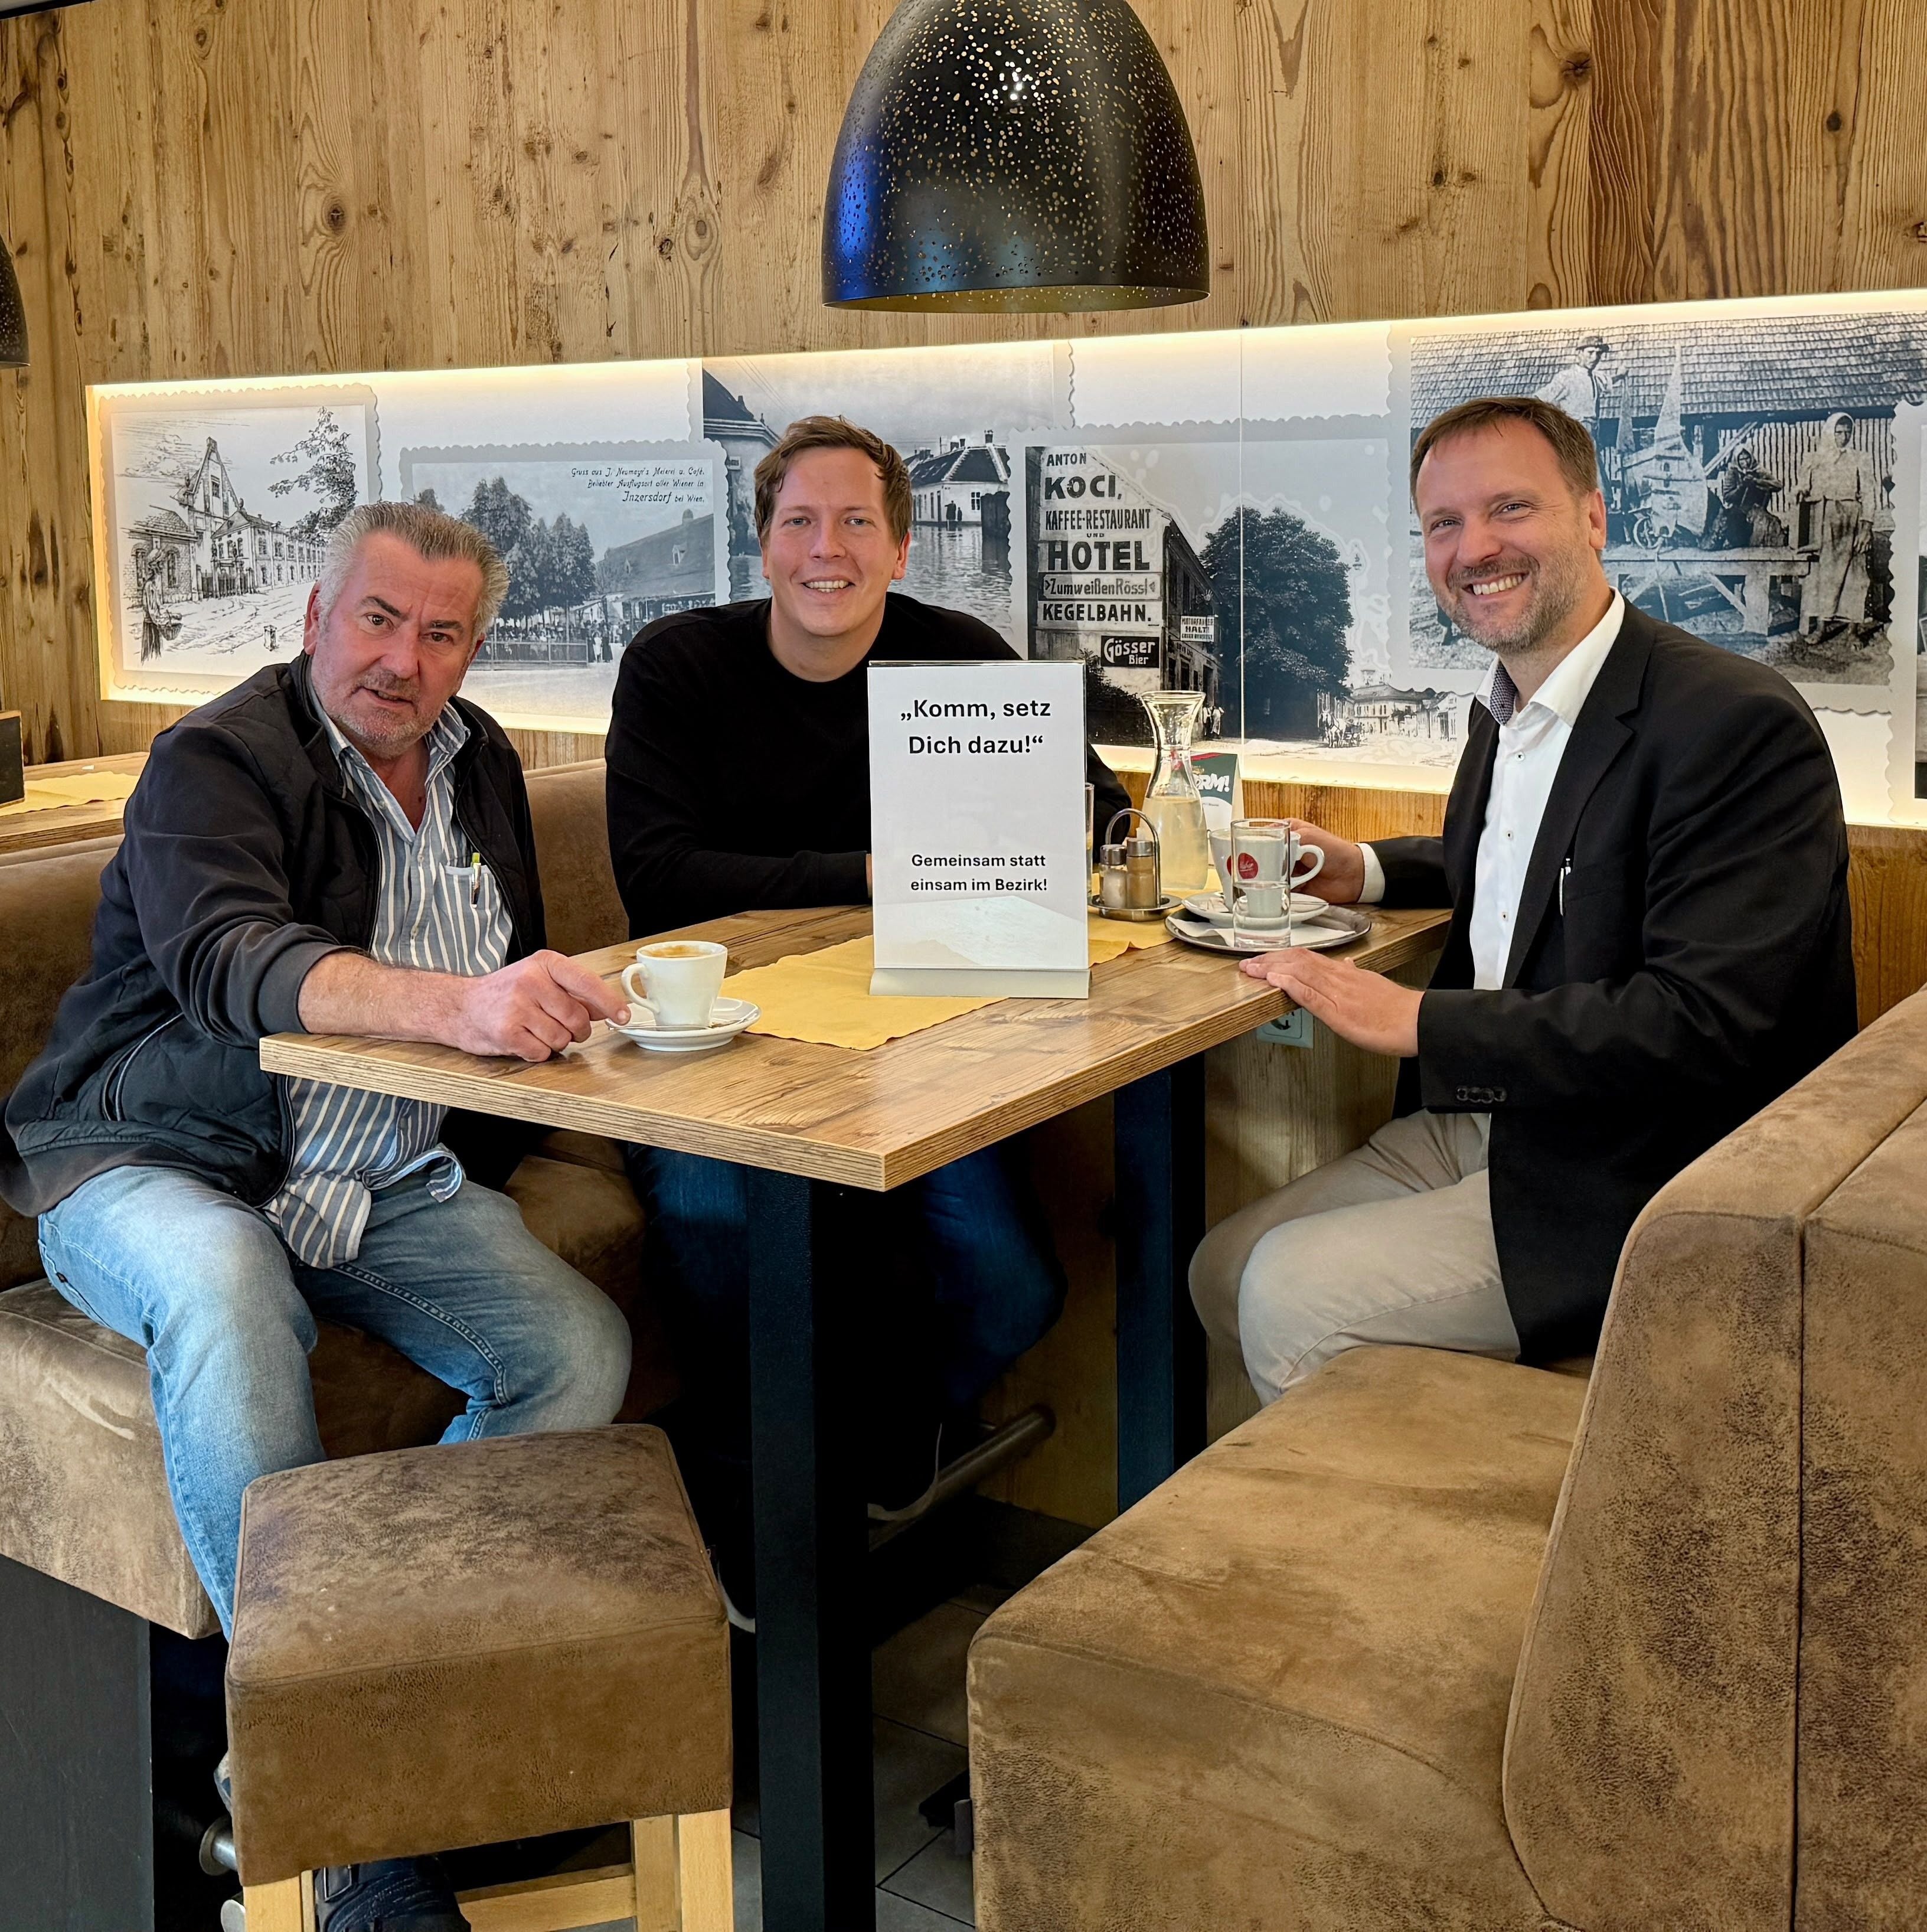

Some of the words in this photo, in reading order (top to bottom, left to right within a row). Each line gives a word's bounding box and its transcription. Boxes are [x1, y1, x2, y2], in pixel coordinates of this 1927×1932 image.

[1047, 453, 1086, 466] ANTON
[1048, 540, 1150, 571] HOTEL
[1043, 603, 1151, 622] KEGELBAHN.
[1103, 638, 1156, 664] Gösser
[1128, 654, 1149, 665] Bier
[901, 699, 996, 721] „Komm,
[1003, 700, 1051, 717] setz
[909, 736, 961, 754] Dich
[968, 735, 1044, 754] dazu!“
[912, 854, 1005, 867] Gemeinsam
[1010, 856, 1046, 867] statt
[911, 879, 967, 891] einsam
[972, 879, 990, 891] im
[995, 879, 1047, 891] Bezirk!
